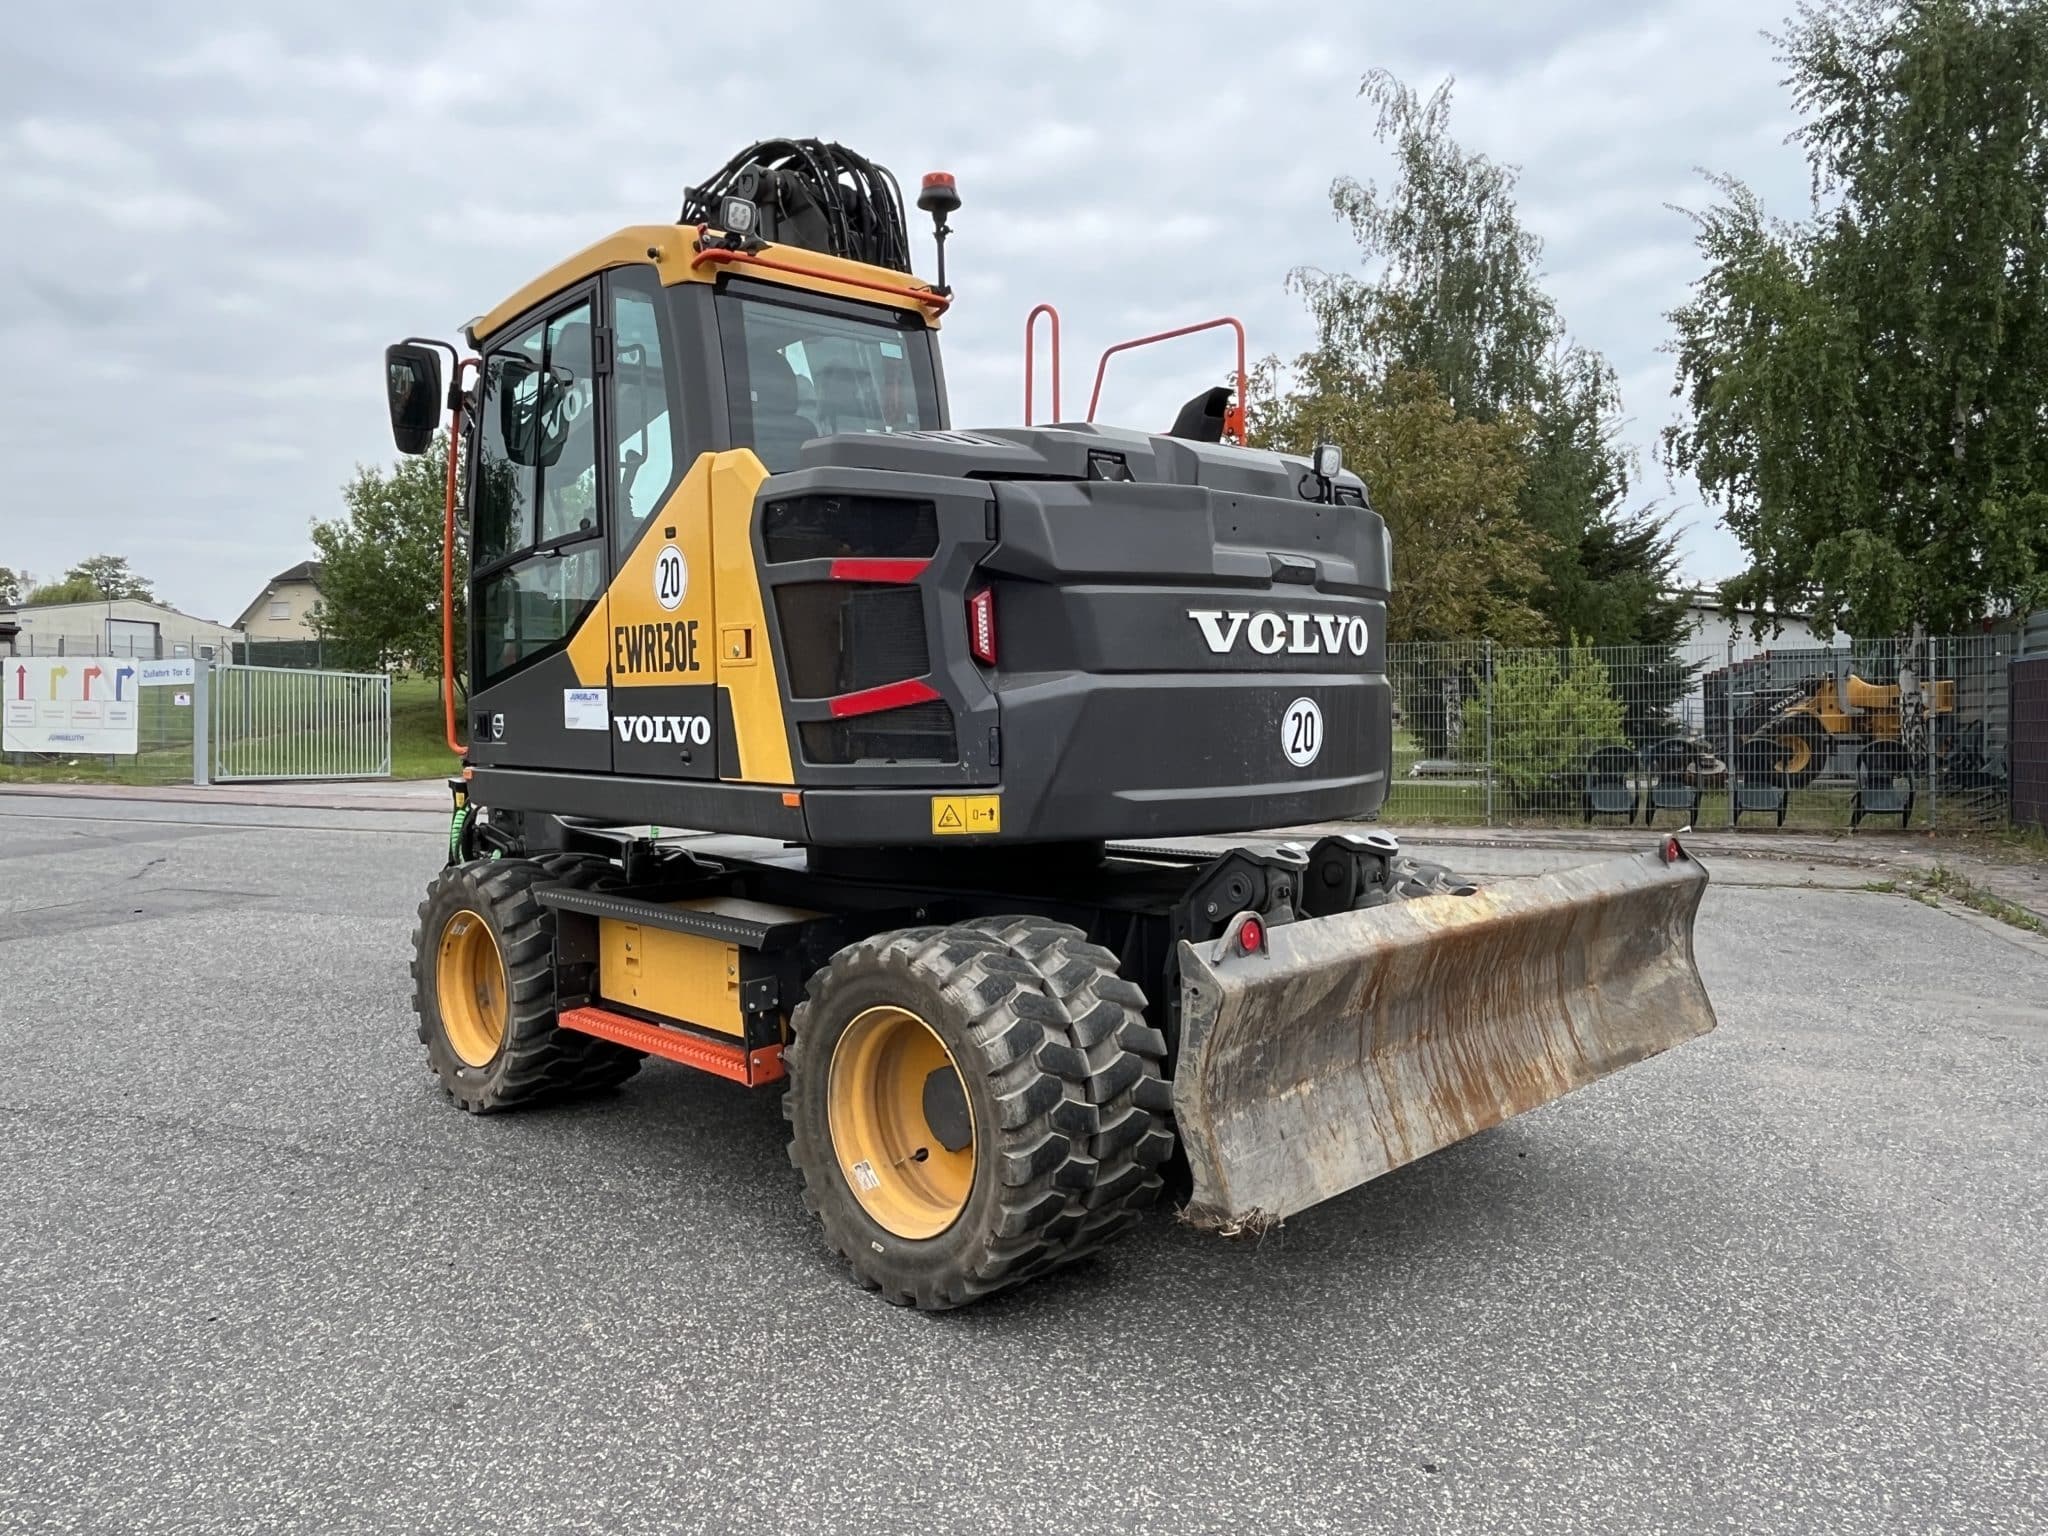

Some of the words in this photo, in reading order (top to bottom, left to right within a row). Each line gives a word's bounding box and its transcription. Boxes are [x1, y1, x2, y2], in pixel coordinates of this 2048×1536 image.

[661, 557, 680, 598] 20
[615, 621, 700, 673] EWR130E
[1188, 609, 1369, 656] VOLVO
[613, 715, 711, 745] VOLVO
[1291, 711, 1315, 753] 20
